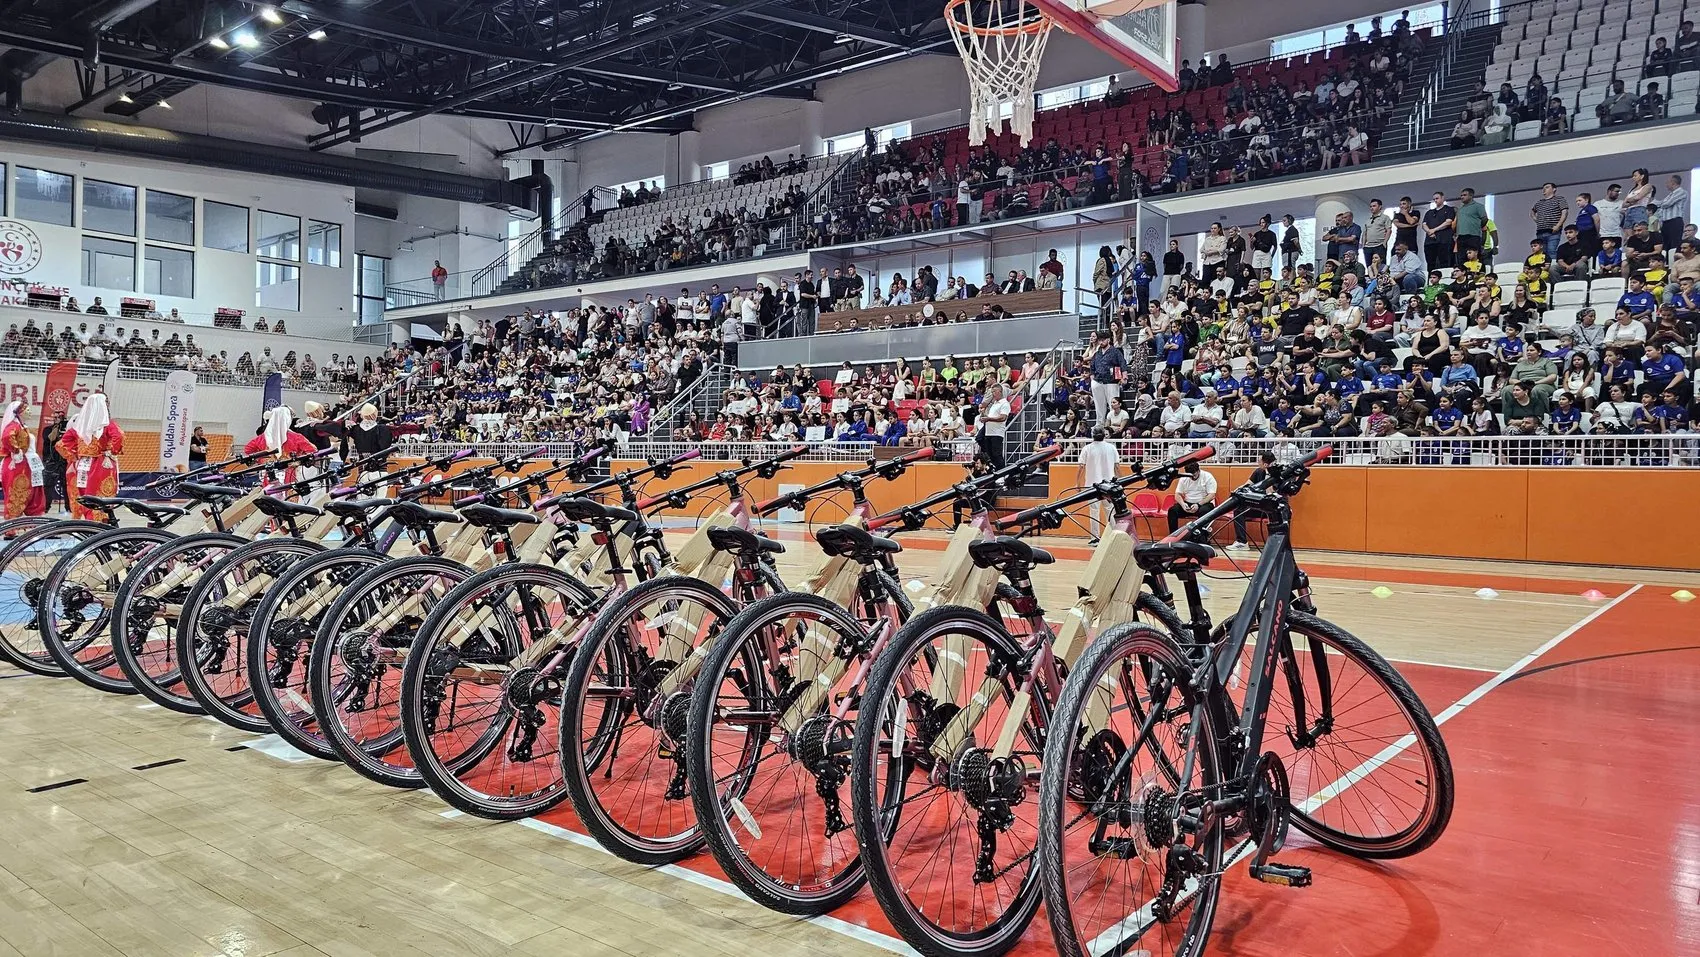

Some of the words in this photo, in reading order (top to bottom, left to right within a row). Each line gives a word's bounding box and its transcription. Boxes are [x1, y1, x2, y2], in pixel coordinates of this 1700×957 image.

[167, 395, 179, 421] Spora
[163, 422, 176, 459] Okuldan
[1265, 599, 1283, 678] SALCANO
[754, 883, 781, 901] SALCANO
